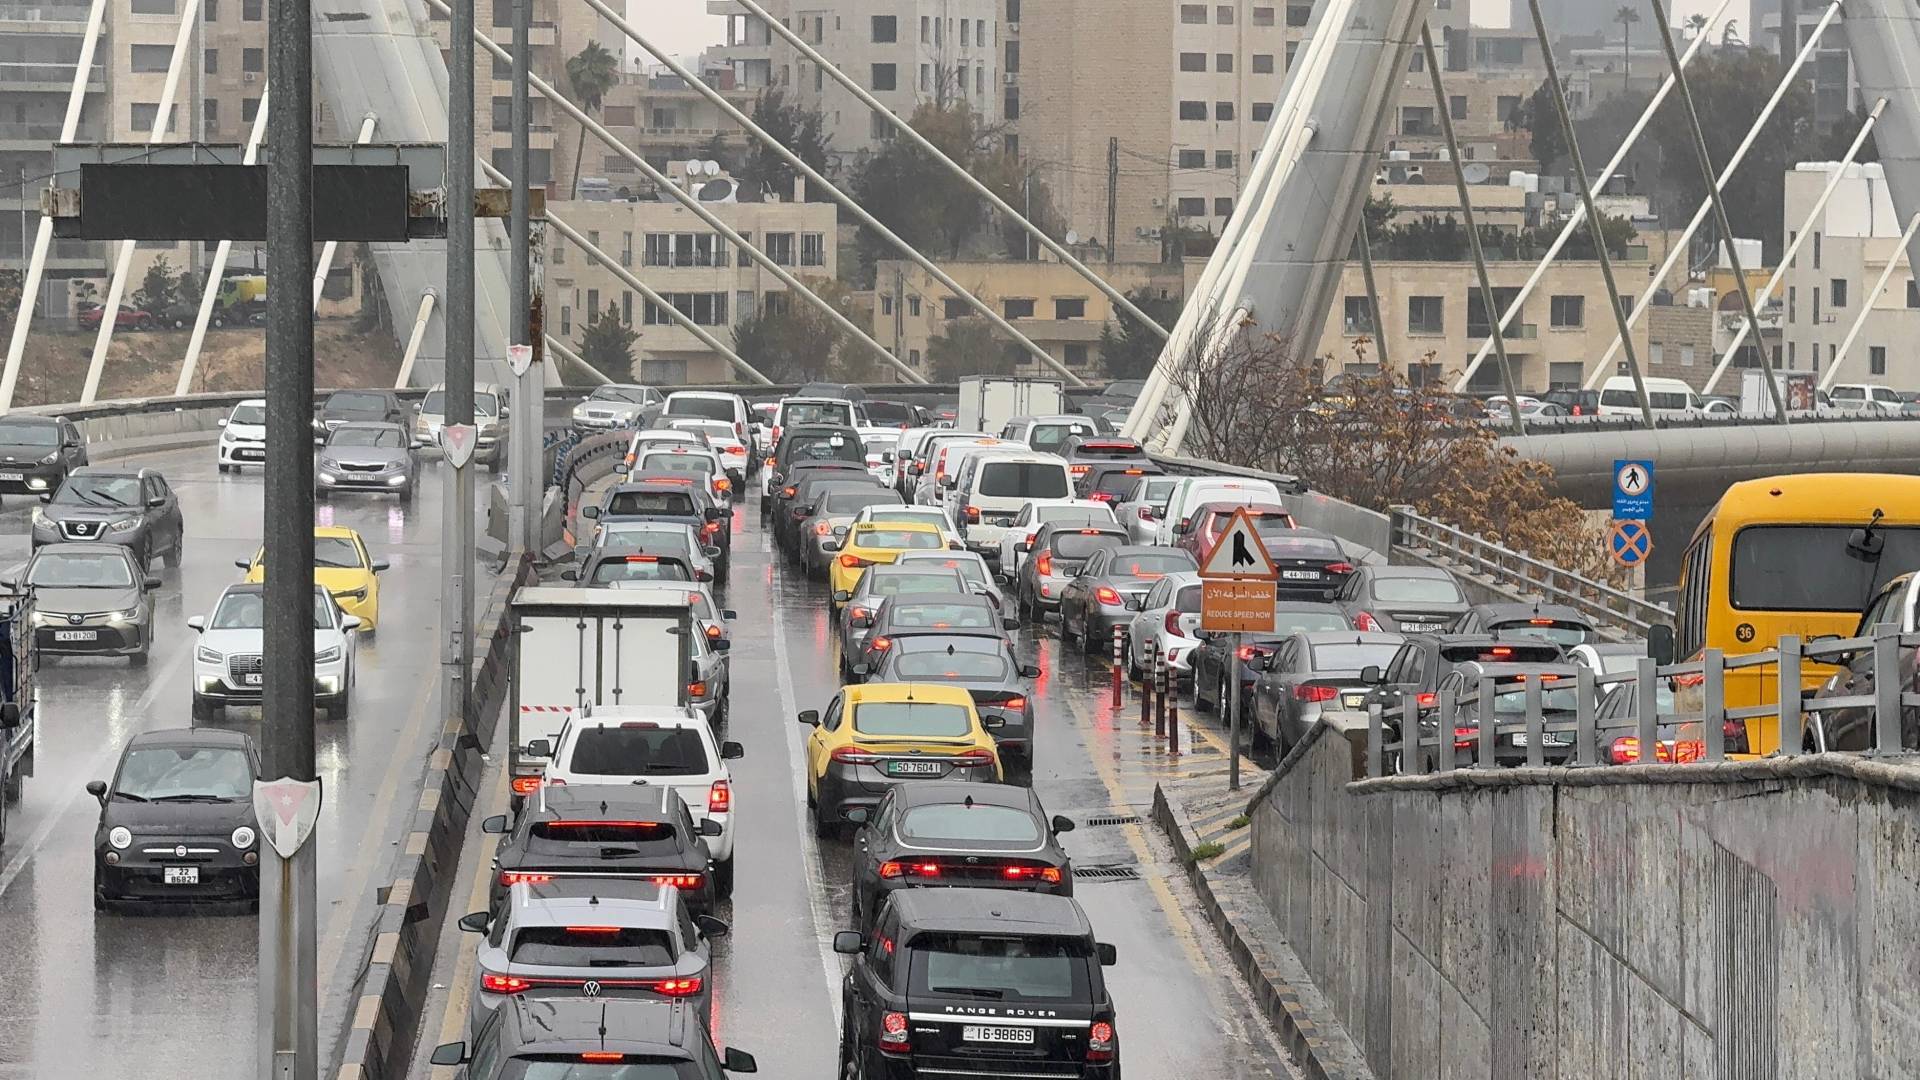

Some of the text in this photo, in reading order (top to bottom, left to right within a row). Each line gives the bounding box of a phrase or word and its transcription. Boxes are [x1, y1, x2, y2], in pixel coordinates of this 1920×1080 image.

[1250, 590, 1271, 599] خفف
[1206, 610, 1271, 619] REDUCE SPEED NOW
[1739, 627, 1752, 639] 36
[945, 1006, 1057, 1017] RANGE ROVER
